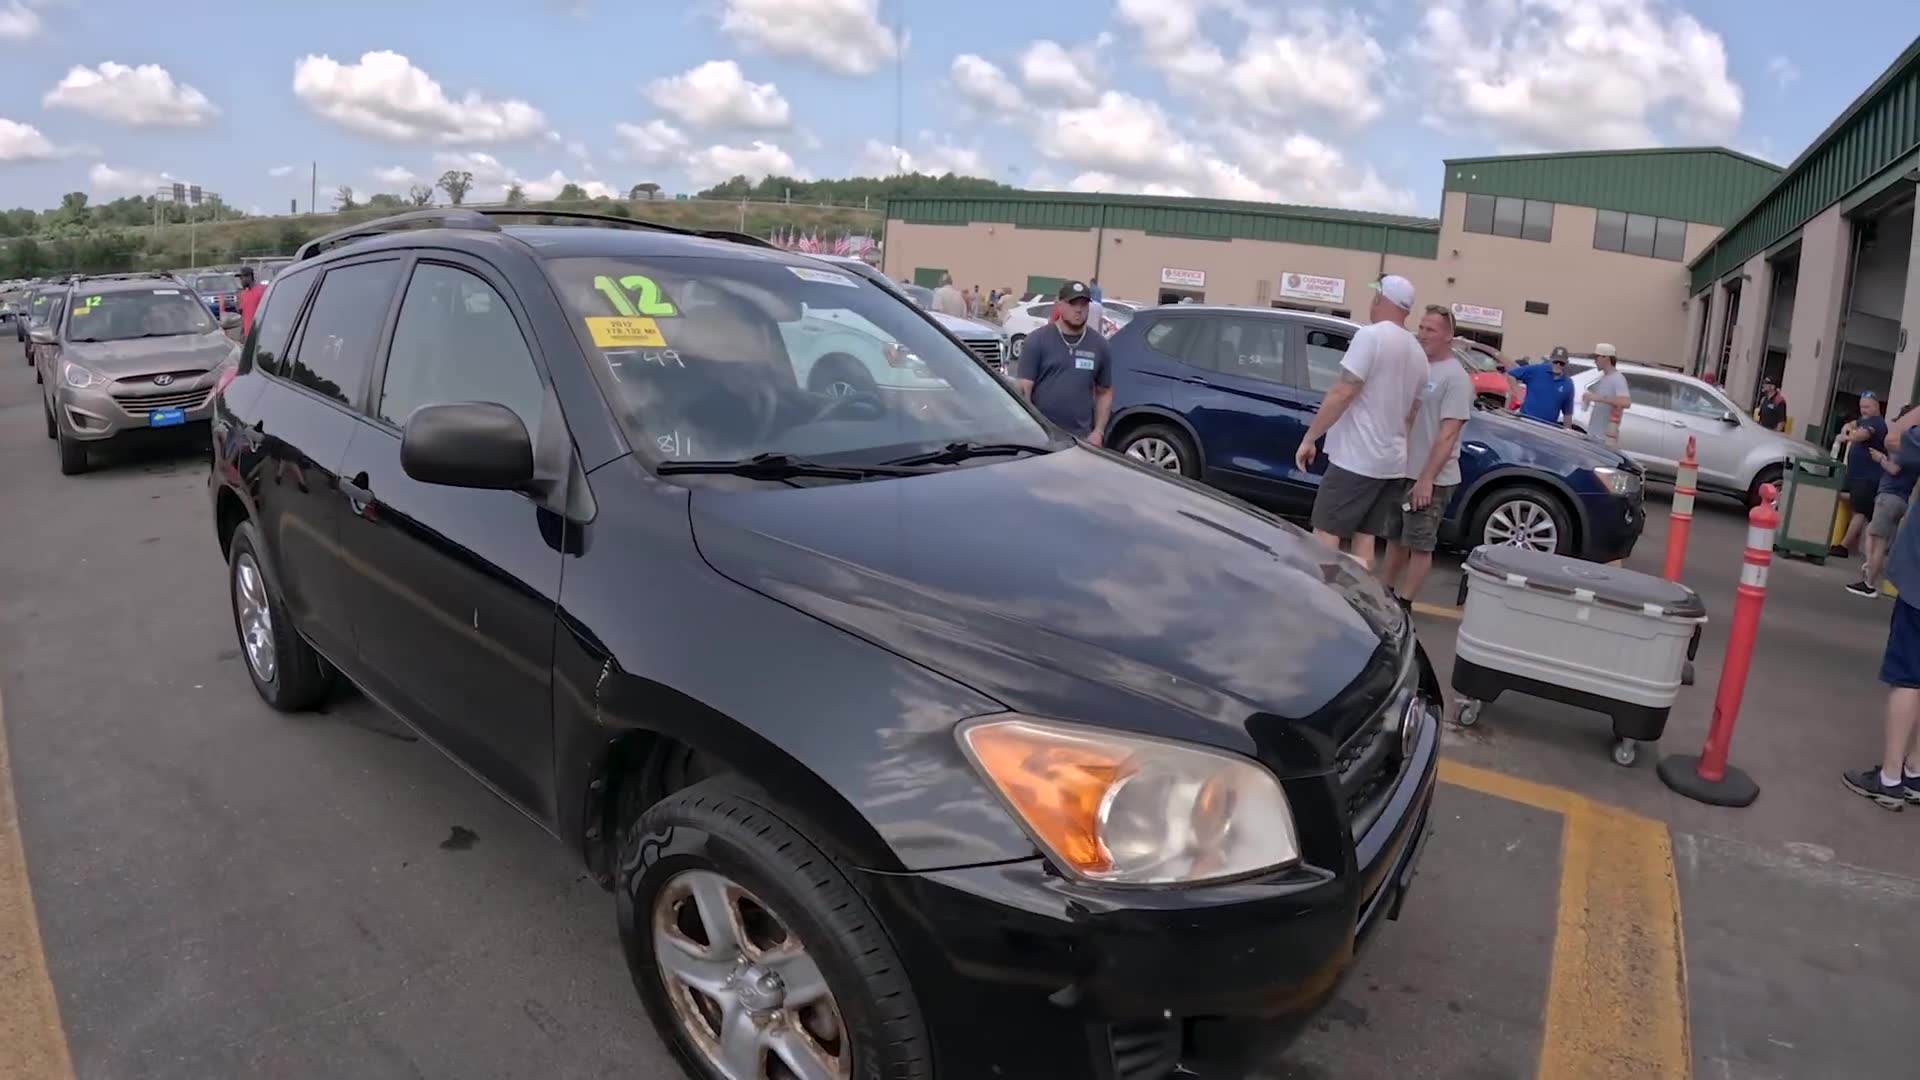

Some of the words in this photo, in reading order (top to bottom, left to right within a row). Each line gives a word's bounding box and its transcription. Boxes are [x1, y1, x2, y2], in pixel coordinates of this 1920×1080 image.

[1171, 270, 1201, 279] SERVICE
[1302, 276, 1339, 287] CUSTOMER
[1306, 284, 1334, 293] SERVICE
[85, 296, 102, 307] 12
[594, 275, 678, 317] 12
